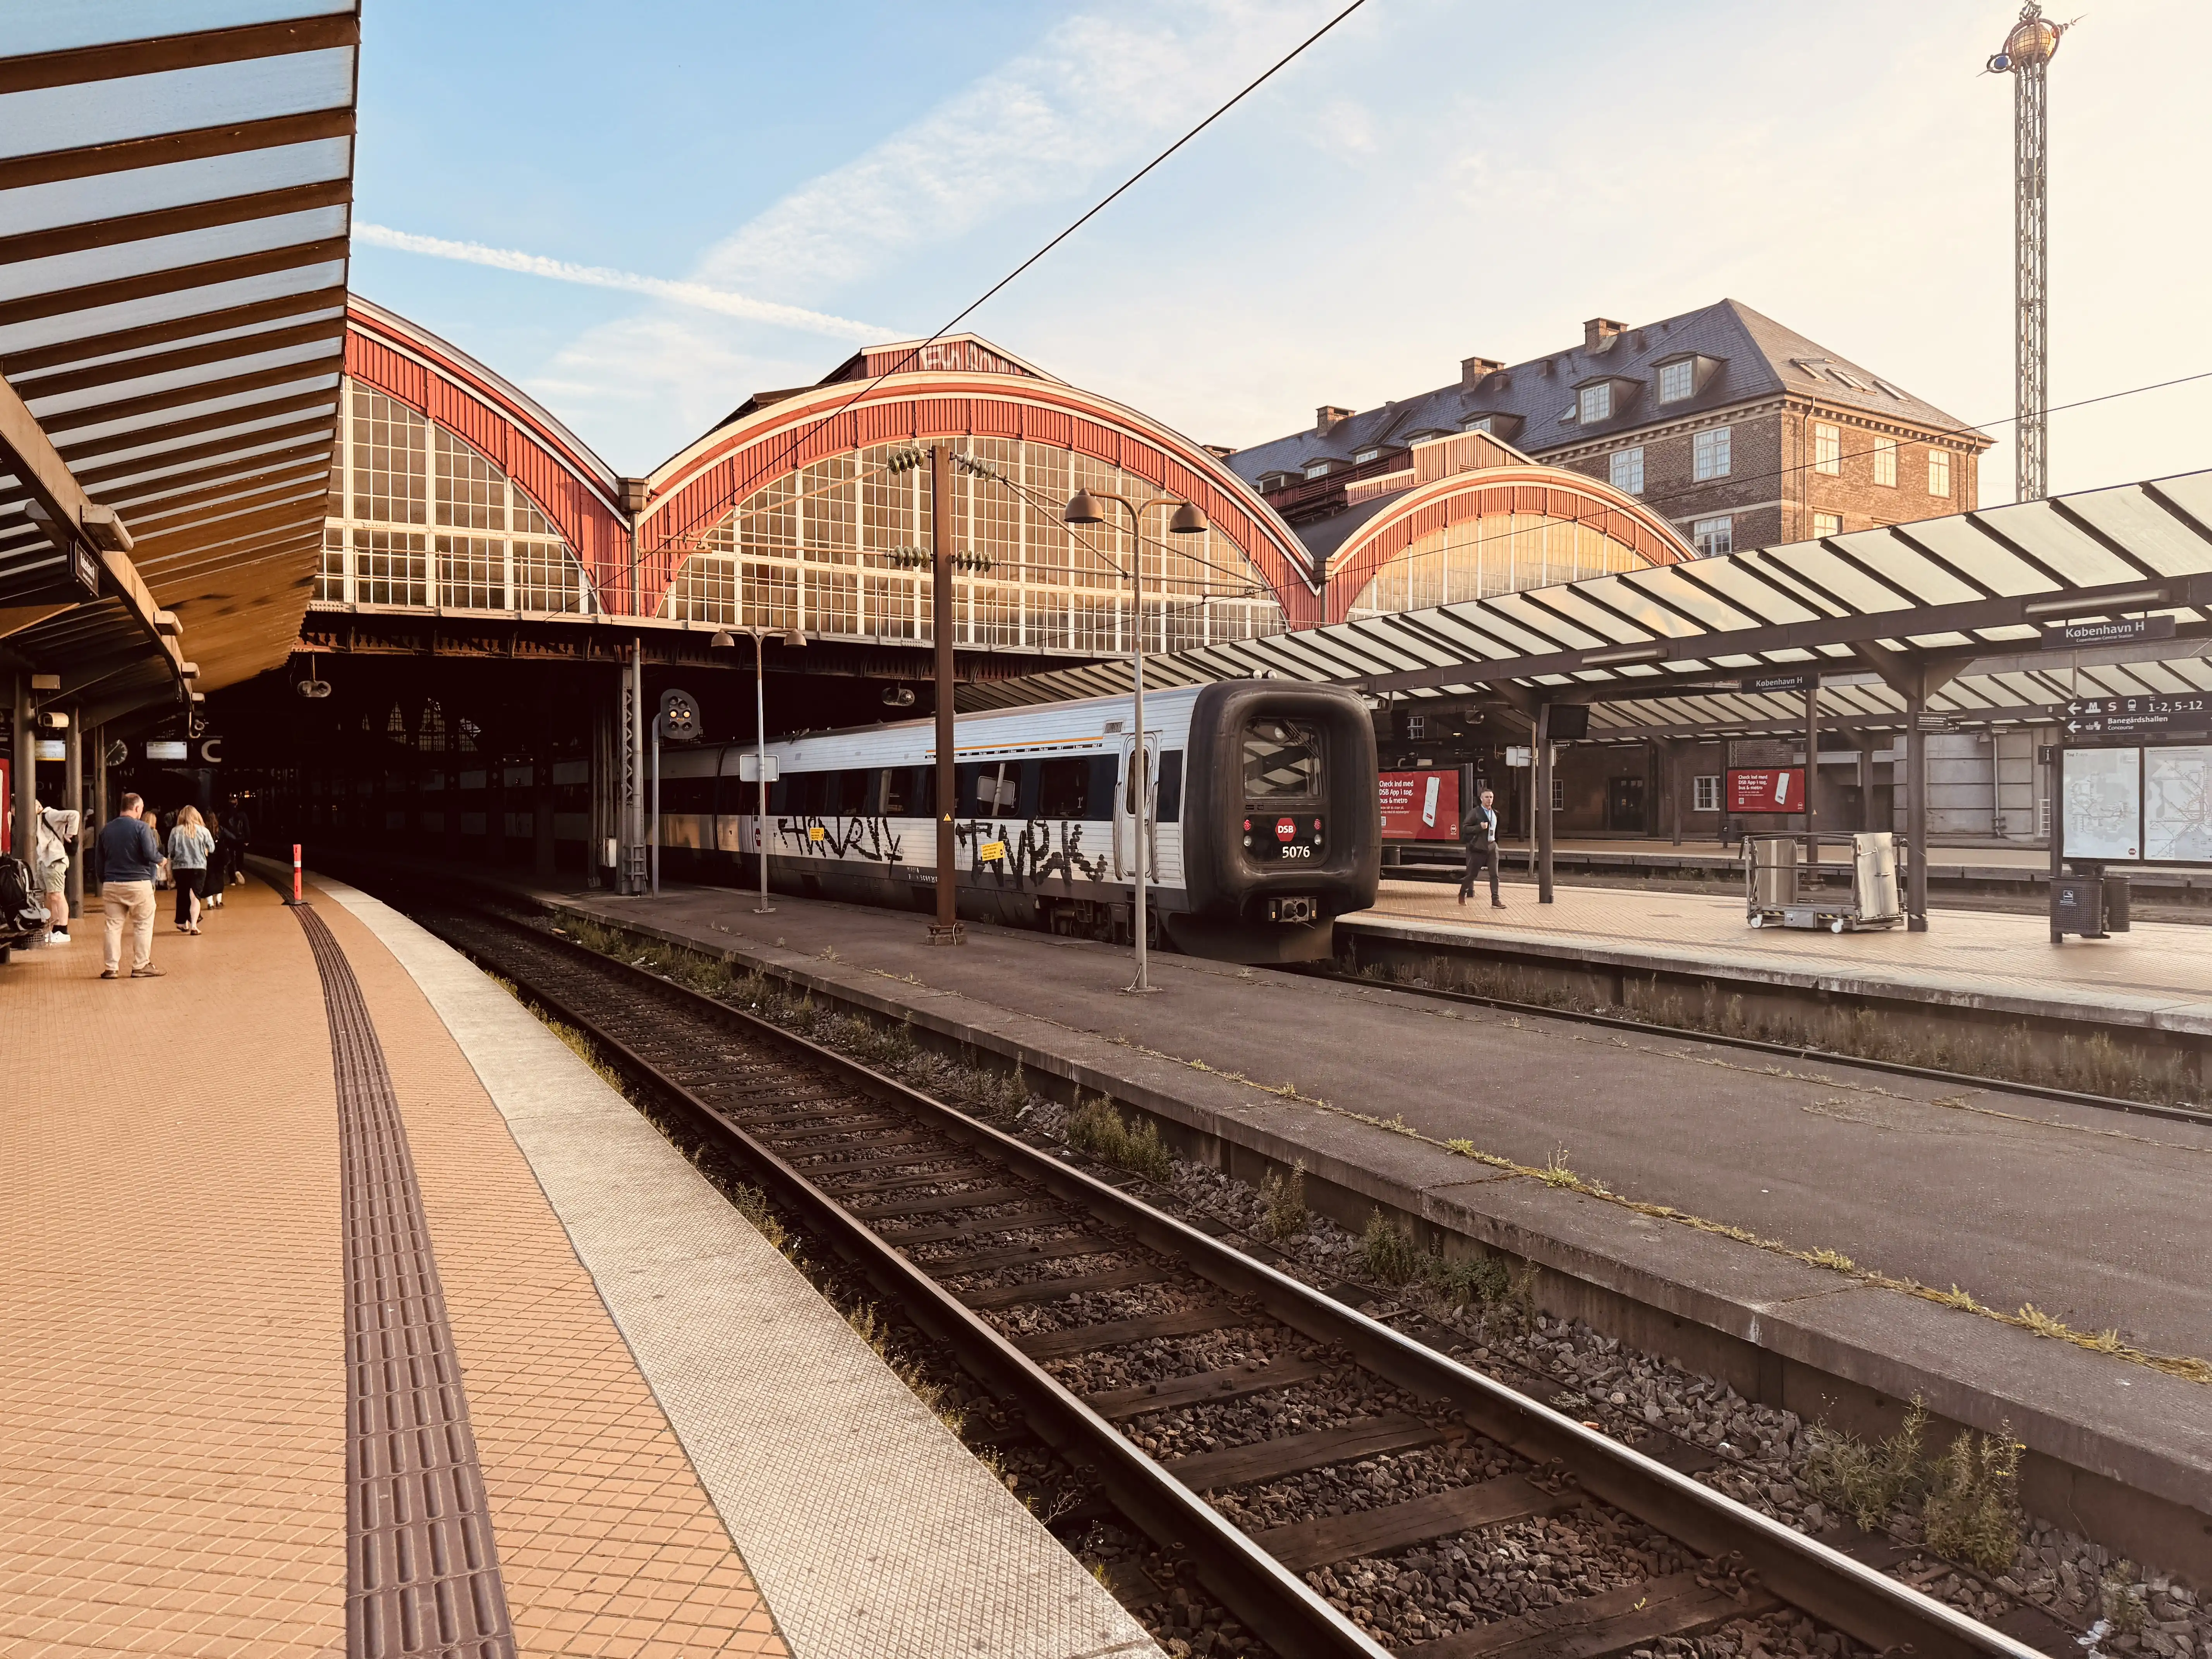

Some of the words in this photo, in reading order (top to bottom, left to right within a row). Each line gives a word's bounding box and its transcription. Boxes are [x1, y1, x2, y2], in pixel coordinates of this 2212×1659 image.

[2066, 624, 2131, 638] København
[2136, 621, 2145, 631] H
[1756, 678, 1795, 687] København
[2108, 702, 2117, 712] S
[2149, 702, 2171, 713] 1-2,
[2174, 701, 2203, 711] 5-12
[2107, 716, 2168, 724] Banegårdshallen
[201, 739, 222, 763] C
[1390, 788, 1400, 797] App
[1278, 825, 1294, 833] DSB
[1282, 846, 1310, 859] 5076
